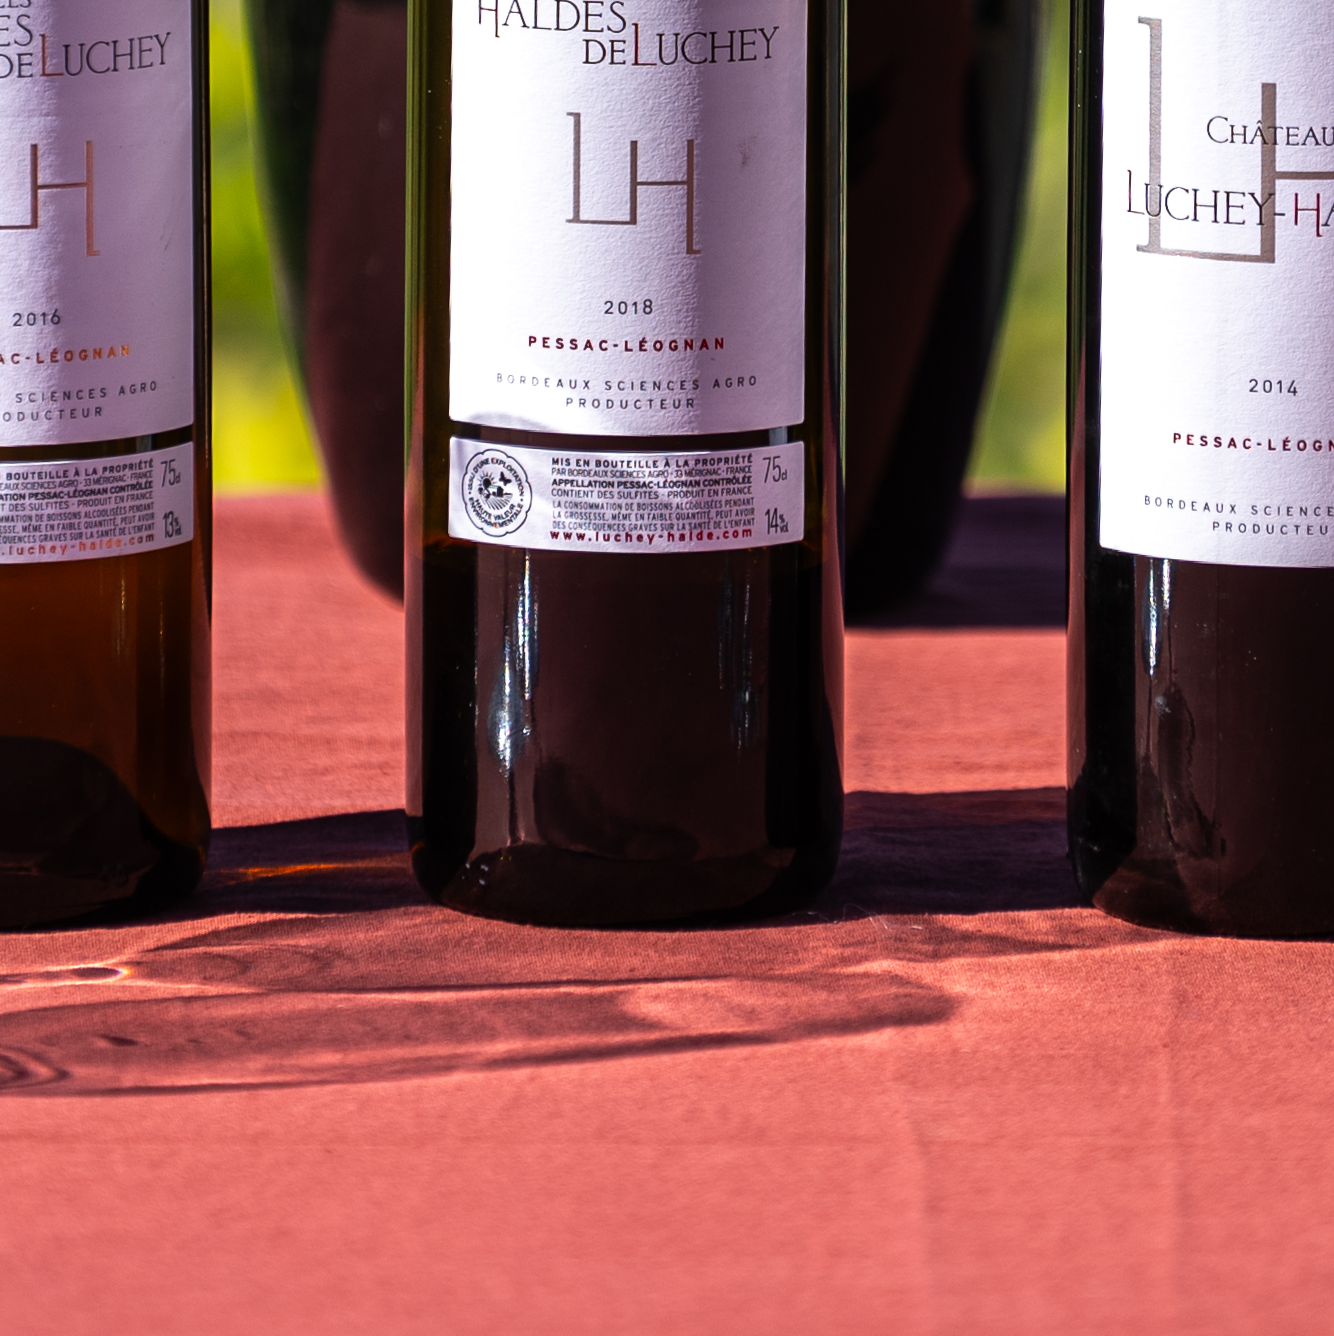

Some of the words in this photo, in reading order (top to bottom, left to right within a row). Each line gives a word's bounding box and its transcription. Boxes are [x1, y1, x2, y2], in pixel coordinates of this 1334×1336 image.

[582, 38, 626, 65] DE
[631, 22, 780, 66] LUCHEY
[38, 31, 171, 77] LUCHEY
[566, 112, 701, 255] LH
[604, 298, 654, 315] 2018
[12, 308, 61, 327] 2016
[528, 335, 725, 352] PESSAC-LÉOGNAN
[496, 372, 591, 390] BORDEAUX
[604, 379, 699, 391] SCIENCES
[712, 375, 757, 390] AGRO
[1249, 379, 1299, 396] 2014
[15, 387, 108, 403] SCIENCES
[118, 380, 157, 396] AGRO
[566, 397, 696, 410] PRODUCTEUR
[6, 469, 69, 481] BOUTEILLE
[85, 468, 97, 476] LA
[102, 458, 153, 474] PROPRIÉTÉ
[552, 458, 571, 466] MIS
[576, 459, 590, 467] EN
[595, 460, 658, 468] BOUTEILLE
[676, 459, 689, 468] LA
[695, 453, 752, 467] PROPRIÉTÉ
[21, 481, 56, 490] SCIENCES
[58, 480, 78, 488] AGRO
[130, 470, 153, 481] FRANCE
[552, 468, 566, 476] PAR
[568, 469, 607, 478] BORDEAUX
[610, 470, 645, 478] SCIENCES
[647, 470, 669, 478] AGRO
[726, 465, 752, 475] FRANCE
[28, 487, 108, 501] PESSAC-LÉOGNAN
[110, 480, 153, 494] CONTRÔLÉE
[552, 479, 614, 488] APPELLATION
[617, 479, 700, 489] PESSAC-LÉOGNAN
[703, 476, 752, 487] CONTRÔLÉE
[9, 504, 26, 512] DES
[29, 501, 69, 512] SULFITES
[77, 497, 112, 508] PRODUIT
[114, 495, 124, 503] EN
[127, 491, 153, 502] FRANCE
[551, 489, 594, 498] CONTIENT
[597, 491, 614, 499] DES
[617, 491, 659, 499] SULFITES
[668, 489, 705, 499] PRODUIT
[708, 488, 718, 497] EN
[721, 486, 752, 496] FRANCE
[35, 514, 44, 522] DE
[47, 511, 81, 522] BOISSONS
[128, 502, 154, 514] PENDANT
[553, 500, 561, 509] LA
[564, 501, 622, 511] CONSOMMATION
[625, 503, 634, 511] DE
[637, 502, 673, 511] BOISSONS
[725, 497, 754, 508] PENDANT
[1144, 495, 1237, 514] BORDEAUX
[45, 524, 54, 532] EN
[57, 521, 81, 531] FAIBLE
[120, 516, 135, 525] PEUT
[138, 512, 154, 522] AVOIR
[553, 511, 561, 519] LA
[635, 513, 644, 521] EN
[647, 513, 673, 522] FAIBLE
[715, 510, 732, 519] PEUT
[735, 507, 755, 517] AVOIR
[38, 533, 67, 543] GRAVES
[69, 532, 83, 541] SUR
[85, 531, 94, 539] LA
[118, 527, 126, 536] DE
[552, 521, 566, 529] DES
[628, 523, 658, 532] GRAVES
[660, 523, 675, 531] SUR
[677, 523, 686, 531] LA
[713, 521, 721, 529] DE
[550, 528, 752, 545] www.luchey-halde.com
